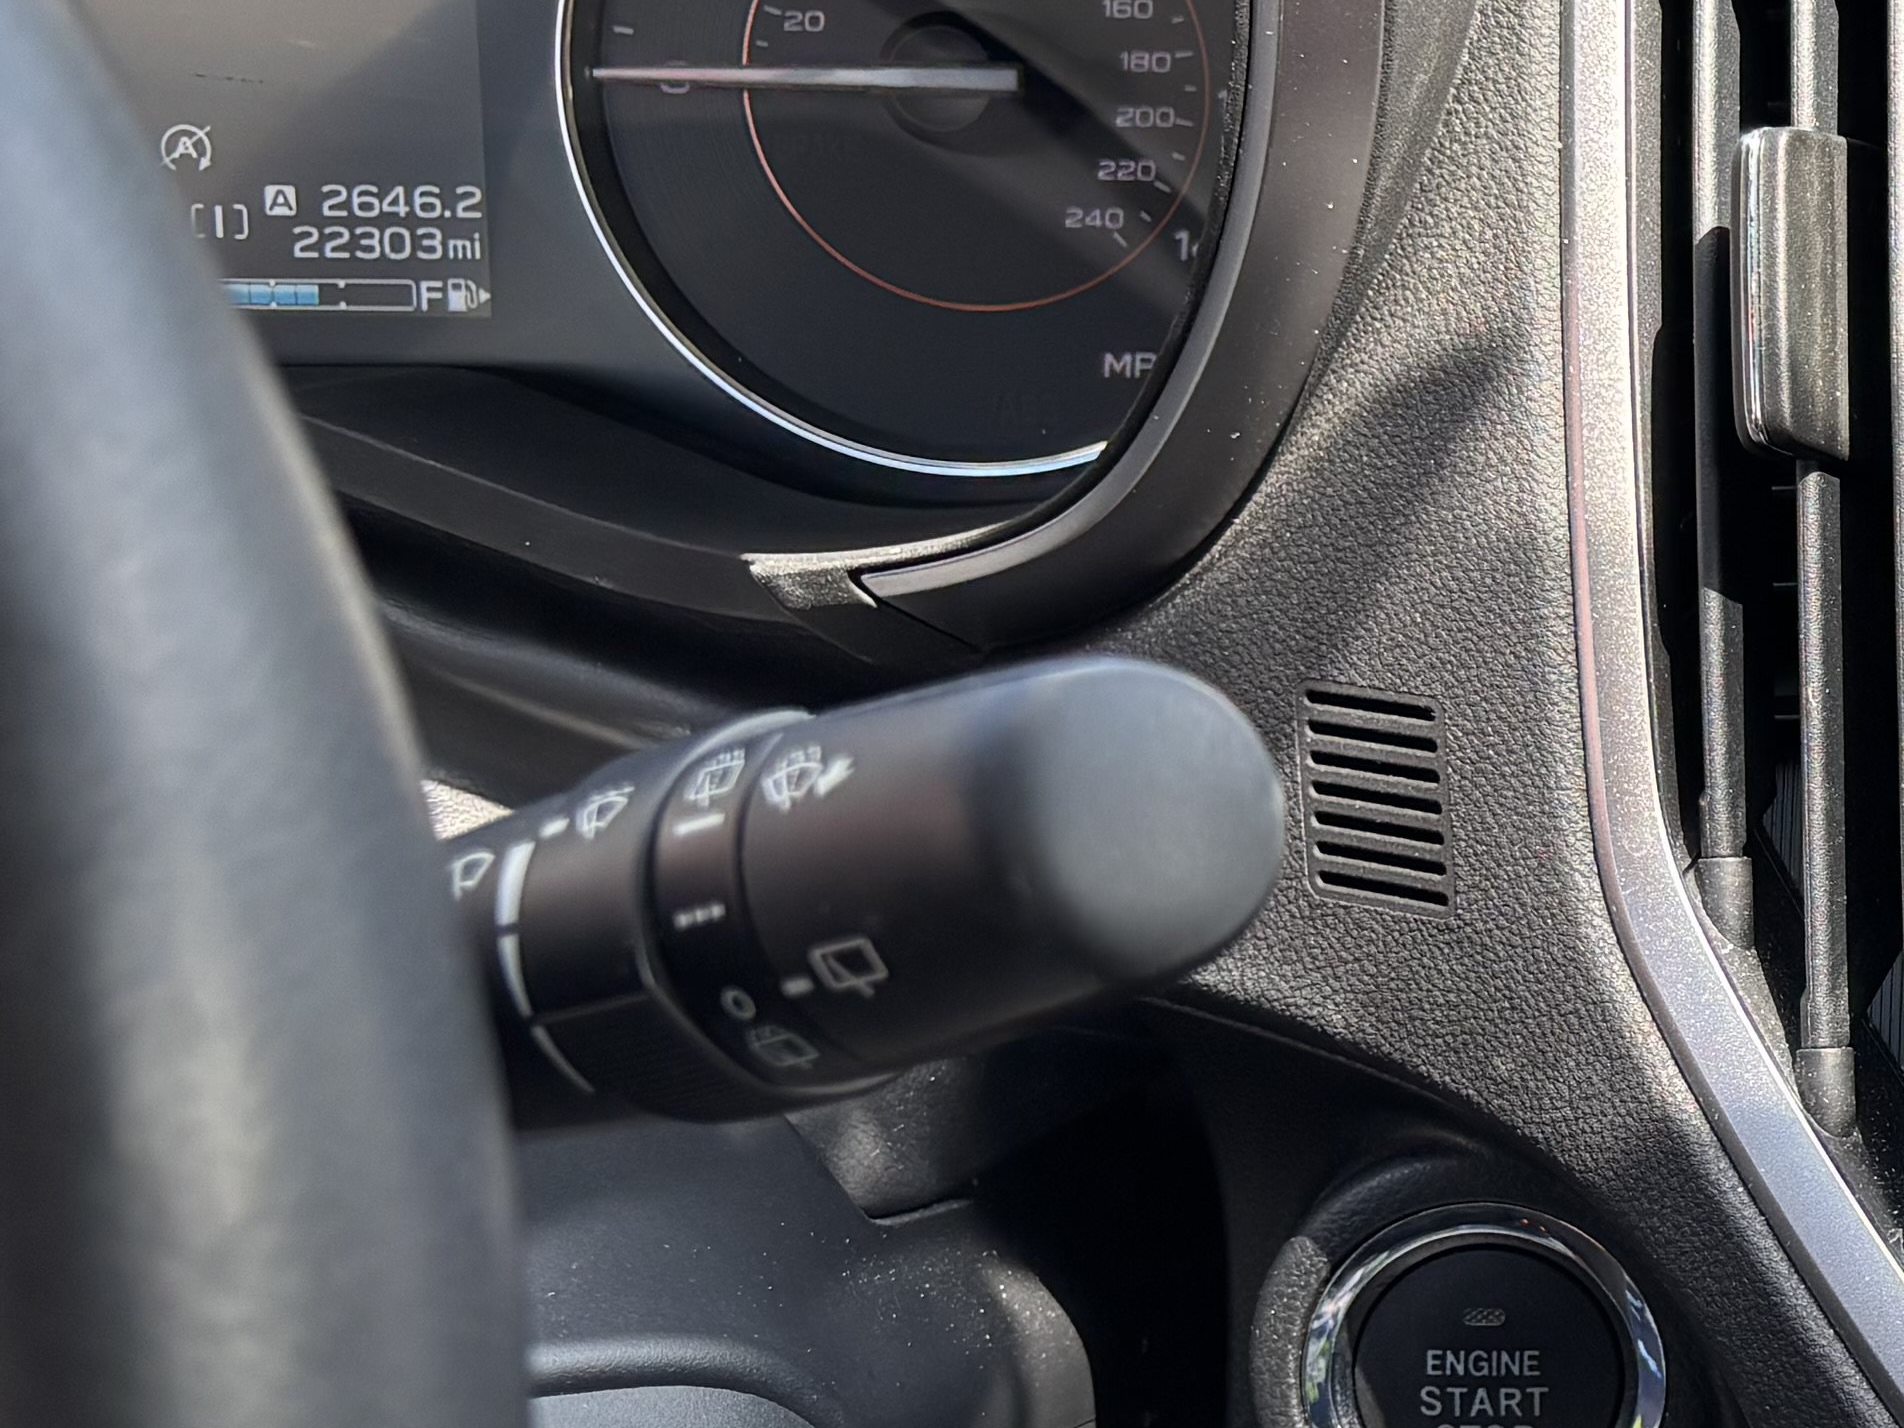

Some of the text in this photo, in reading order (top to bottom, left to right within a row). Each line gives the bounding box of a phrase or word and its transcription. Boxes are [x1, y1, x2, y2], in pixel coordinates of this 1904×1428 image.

[784, 10, 825, 32] 20
[1120, 51, 1171, 73] 180
[1114, 106, 1177, 127] 200
[1097, 159, 1157, 181] 220
[321, 184, 482, 218] 2646.2
[1065, 207, 1124, 229] 240
[420, 281, 443, 312] F
[1104, 353, 1156, 378] MP
[1426, 1349, 1540, 1376] ENGINE
[1420, 1386, 1548, 1417] START
